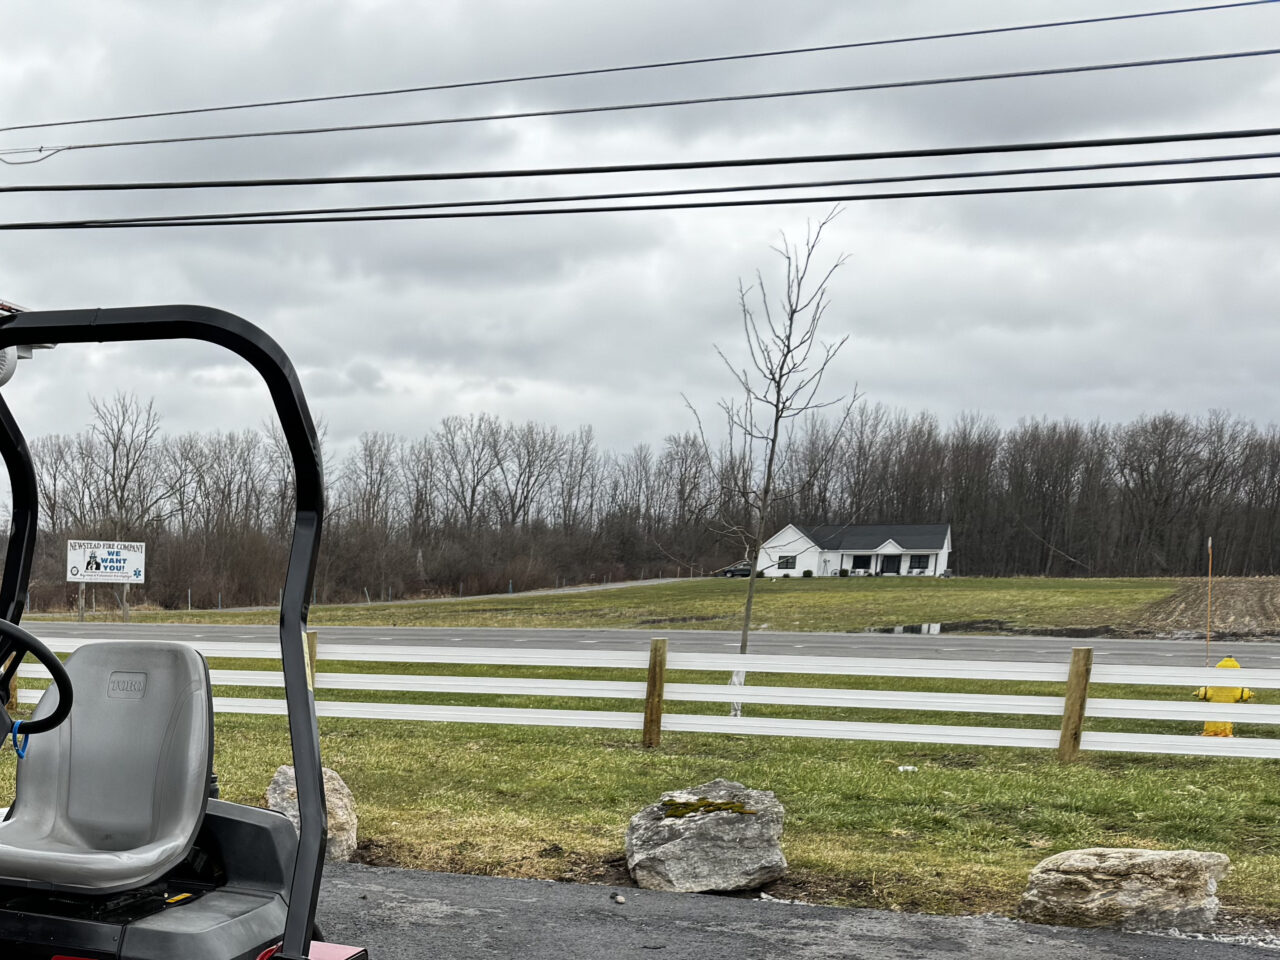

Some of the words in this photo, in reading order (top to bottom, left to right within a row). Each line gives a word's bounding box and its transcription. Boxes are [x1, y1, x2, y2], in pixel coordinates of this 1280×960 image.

[69, 541, 101, 551] NEWSTEAD
[102, 542, 115, 550] FIRE
[116, 543, 144, 554] COMPANY
[110, 679, 144, 691] TORO
